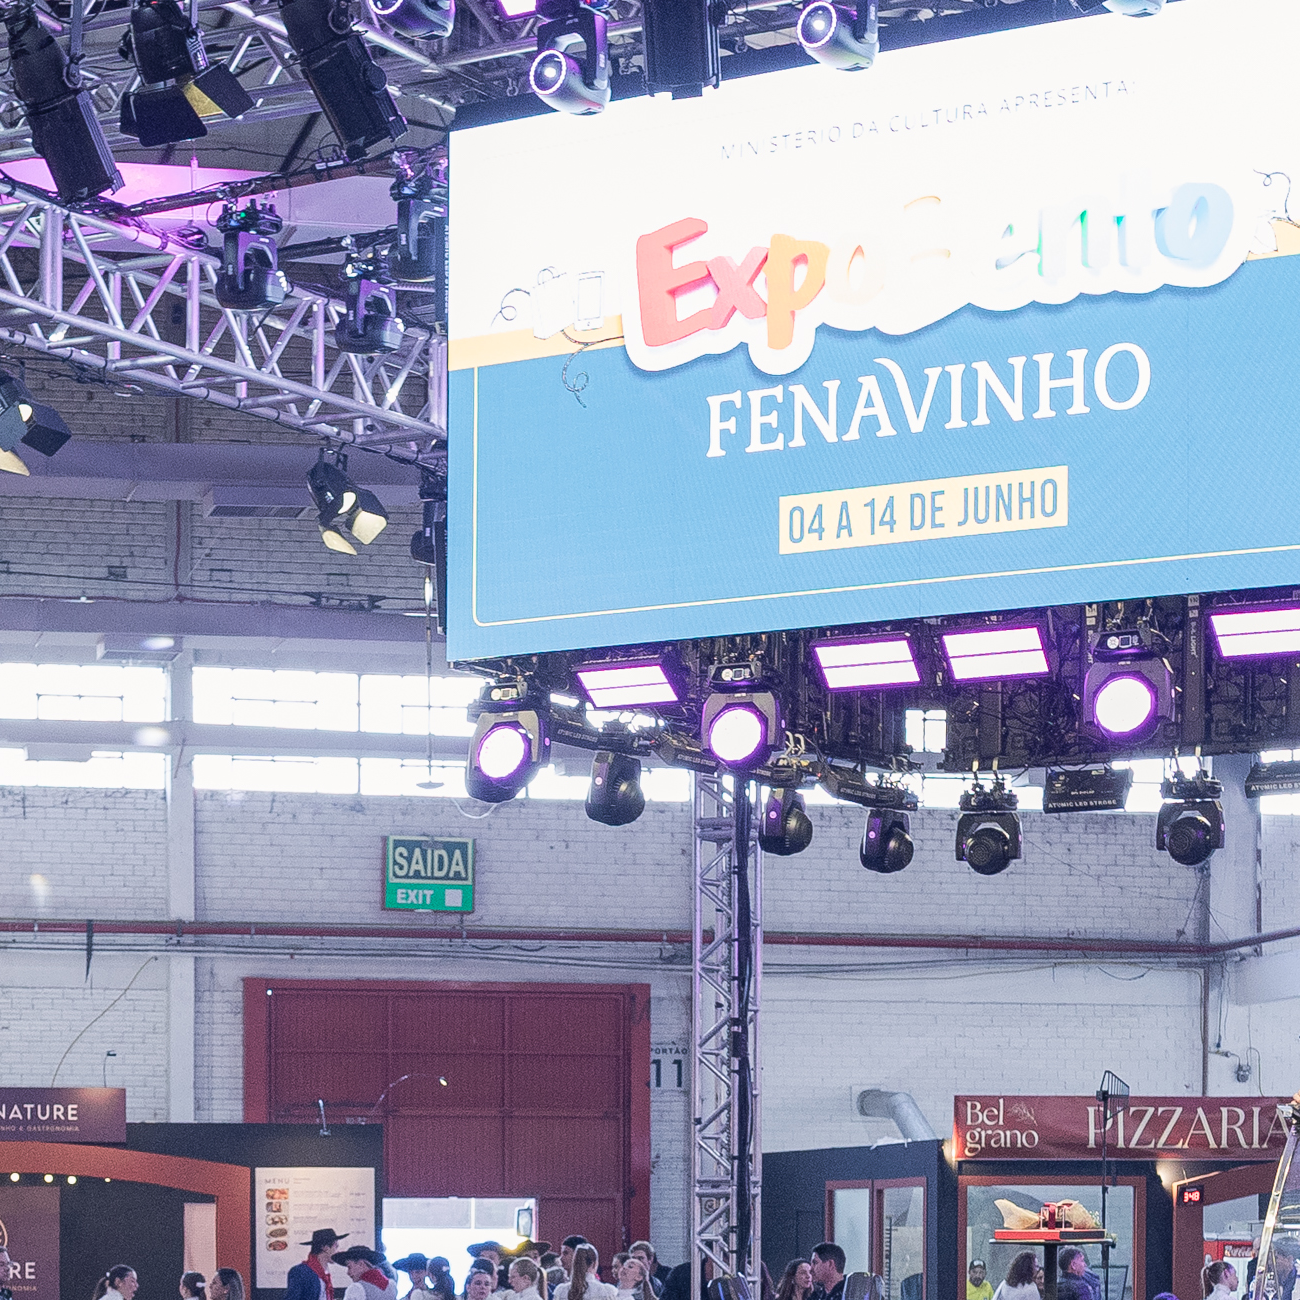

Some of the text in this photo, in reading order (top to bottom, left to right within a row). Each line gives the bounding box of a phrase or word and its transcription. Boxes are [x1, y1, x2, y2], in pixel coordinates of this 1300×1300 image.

[852, 120, 879, 139] DA
[888, 102, 988, 133] CULTURA
[705, 340, 1151, 458] FENAVINHO
[788, 477, 1058, 544] 04 A 14 DE JUNHO
[397, 888, 434, 905] EXIT
[651, 1058, 682, 1088] 11
[965, 1097, 1004, 1127] Bel
[1086, 1105, 1290, 1150] PIZZARIA
[965, 1129, 1039, 1157] grano
